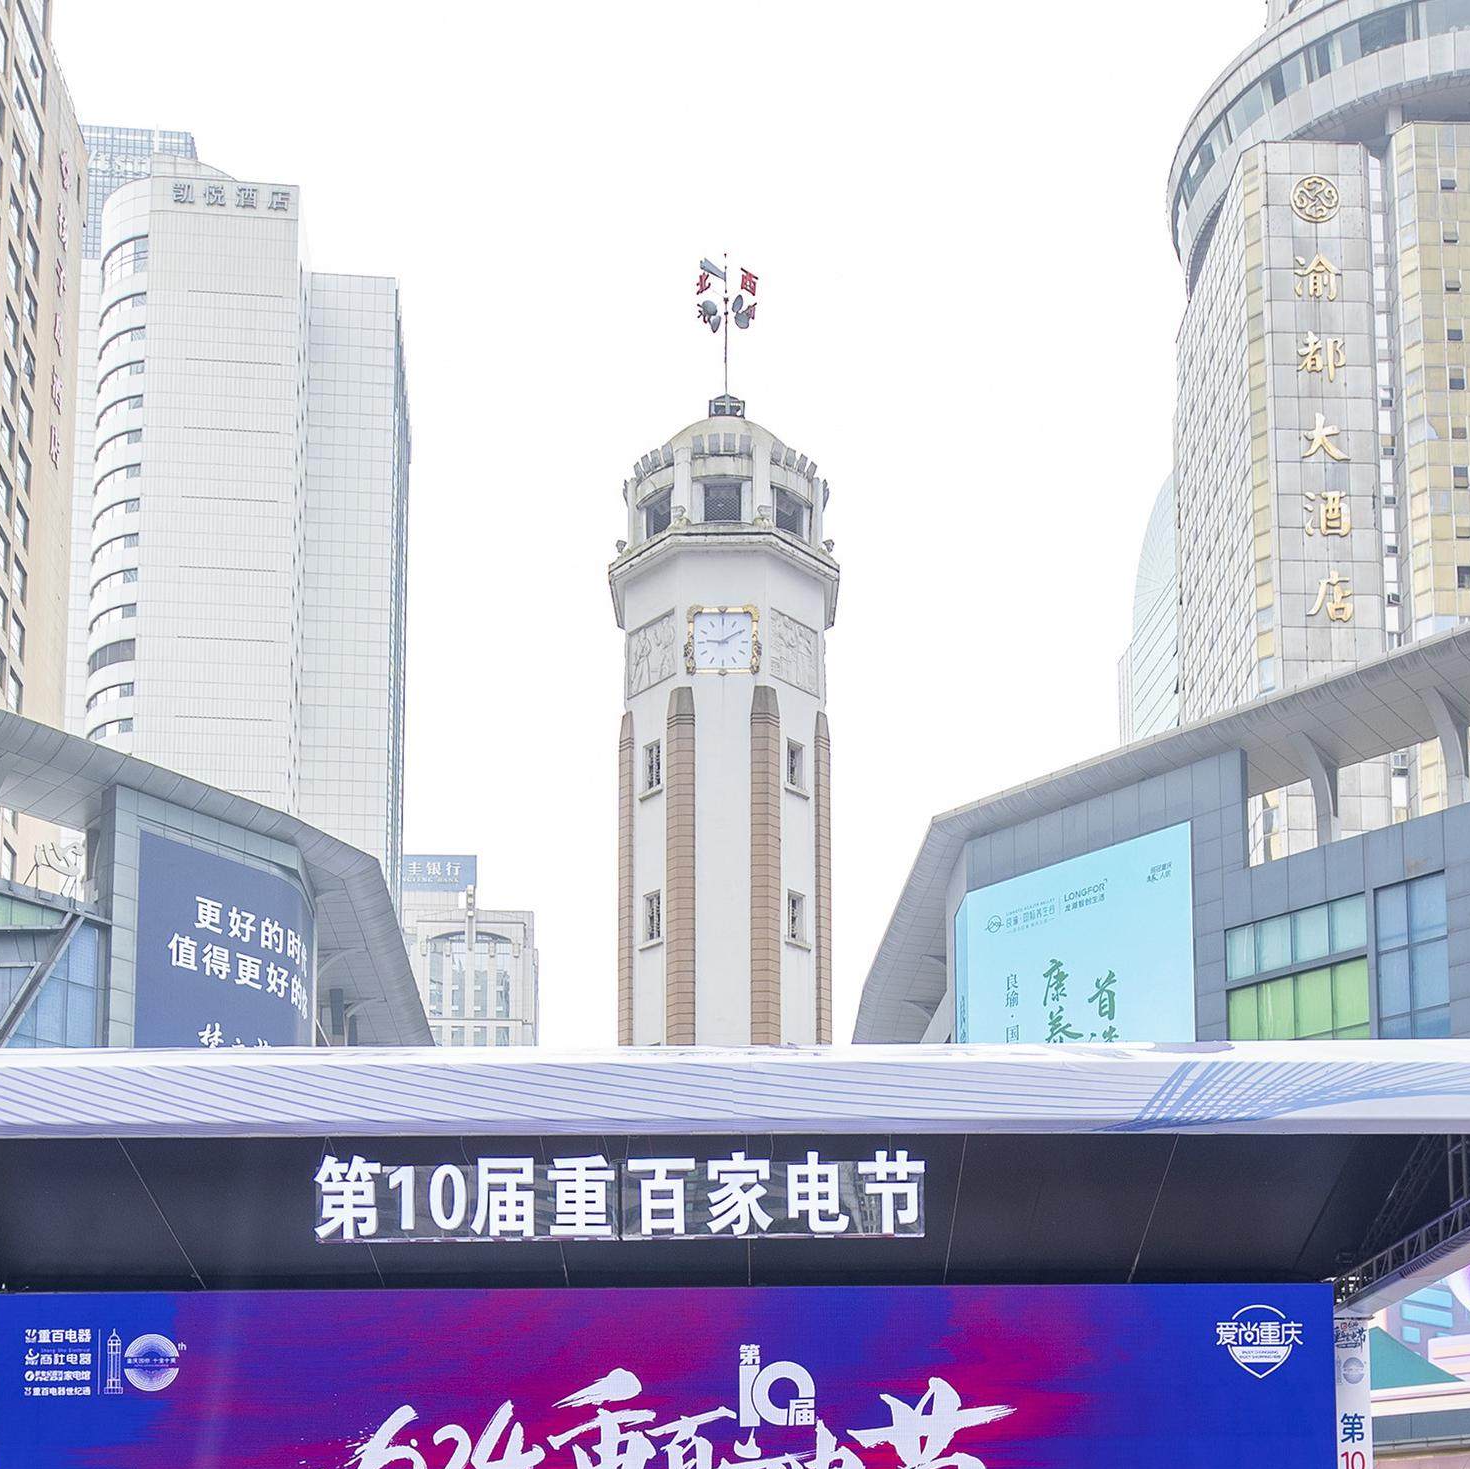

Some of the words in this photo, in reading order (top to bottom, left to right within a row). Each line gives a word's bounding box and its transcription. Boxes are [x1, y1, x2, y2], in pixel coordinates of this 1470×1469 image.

[172, 182, 291, 211] 凯悦酒店
[1293, 252, 1354, 622] 渝都大酒店
[1064, 882, 1106, 902] LONGFOR
[313, 1151, 926, 1240] 第10届重百家电节
[37, 1328, 92, 1343] 重百电器
[1215, 1320, 1304, 1346] 爱尚重庆
